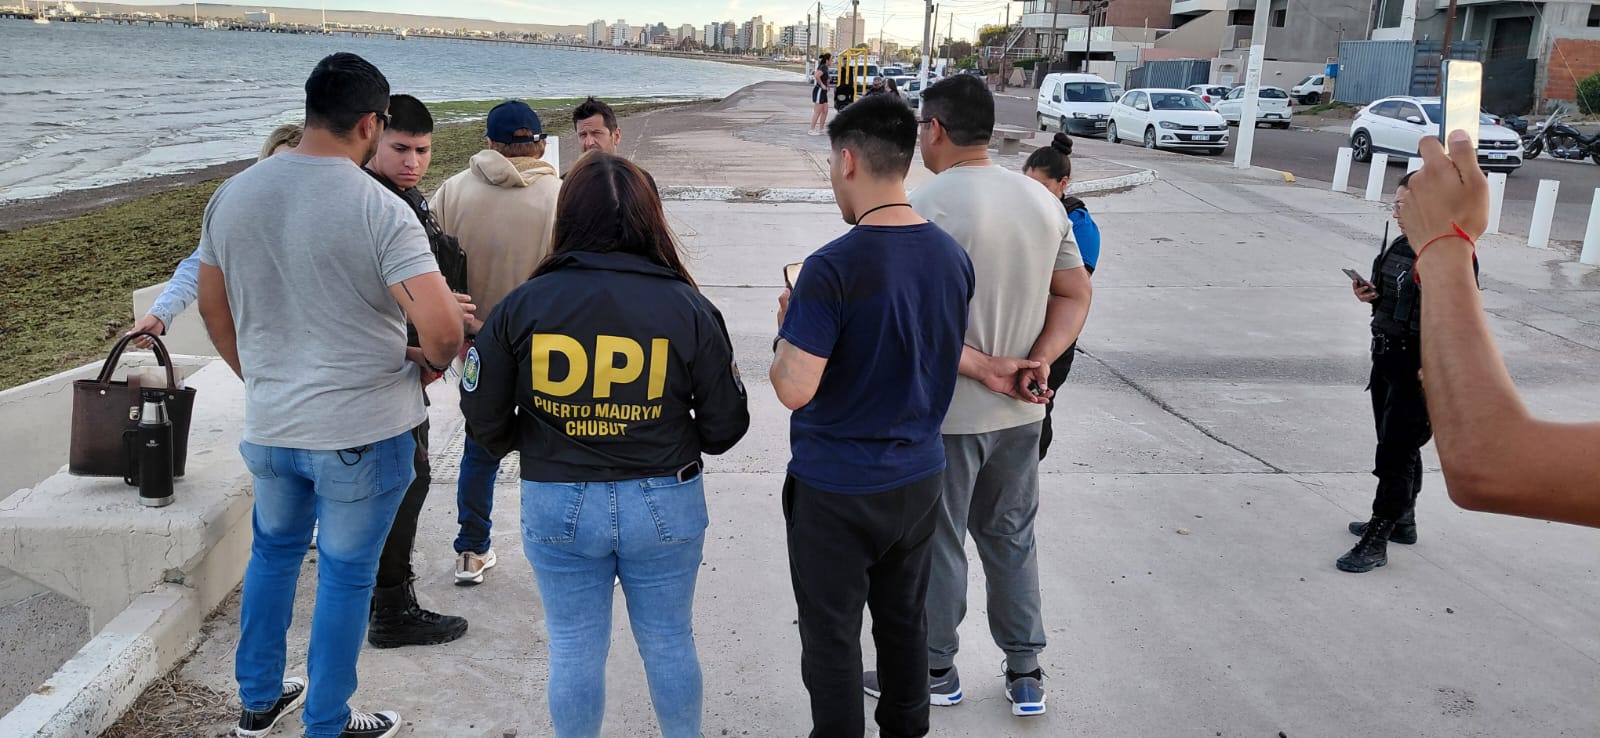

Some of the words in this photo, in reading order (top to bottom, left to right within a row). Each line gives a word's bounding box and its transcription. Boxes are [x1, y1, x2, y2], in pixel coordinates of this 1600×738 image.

[531, 333, 669, 400] DPI
[533, 395, 591, 418] PUERTO
[594, 403, 662, 421] MADRYN
[565, 420, 628, 436] CHUBUT
